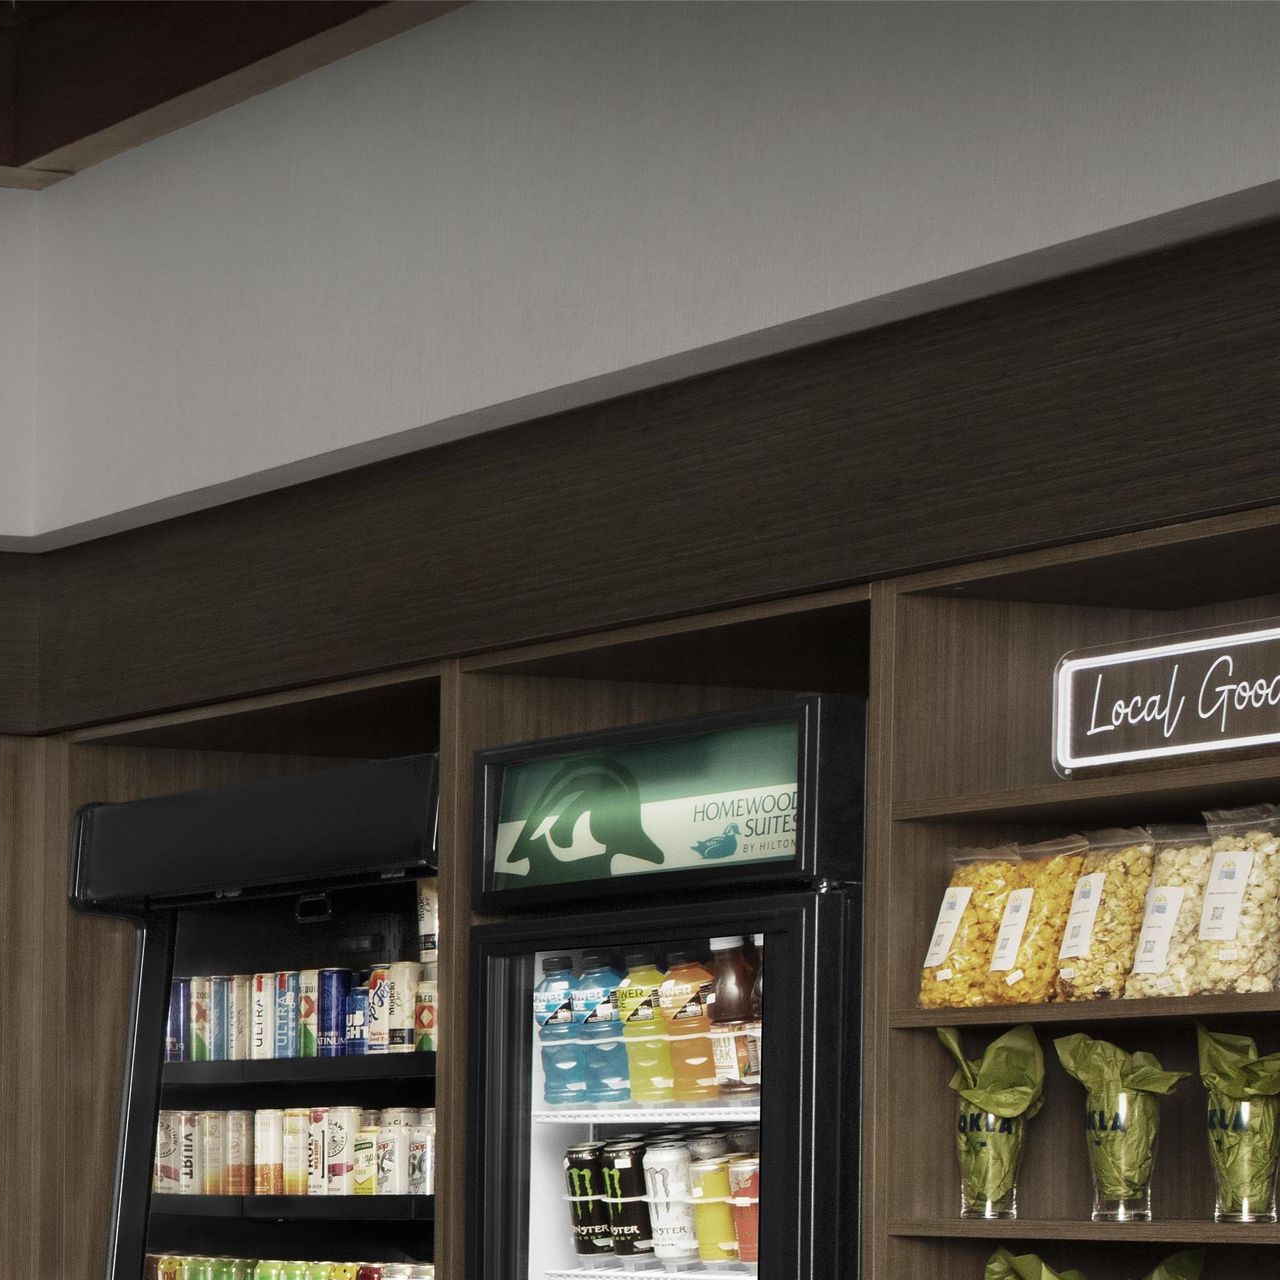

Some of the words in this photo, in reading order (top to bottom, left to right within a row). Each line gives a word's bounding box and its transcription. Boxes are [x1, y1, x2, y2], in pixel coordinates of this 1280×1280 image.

[1086, 664, 1186, 738] Local
[743, 843, 756, 853] BY
[759, 839, 796, 851] HILTON
[255, 998, 264, 1048] ULTRA
[276, 995, 287, 1046] ULTRA
[1086, 1109, 1127, 1132] KLA
[1208, 1108, 1248, 1131] KLA
